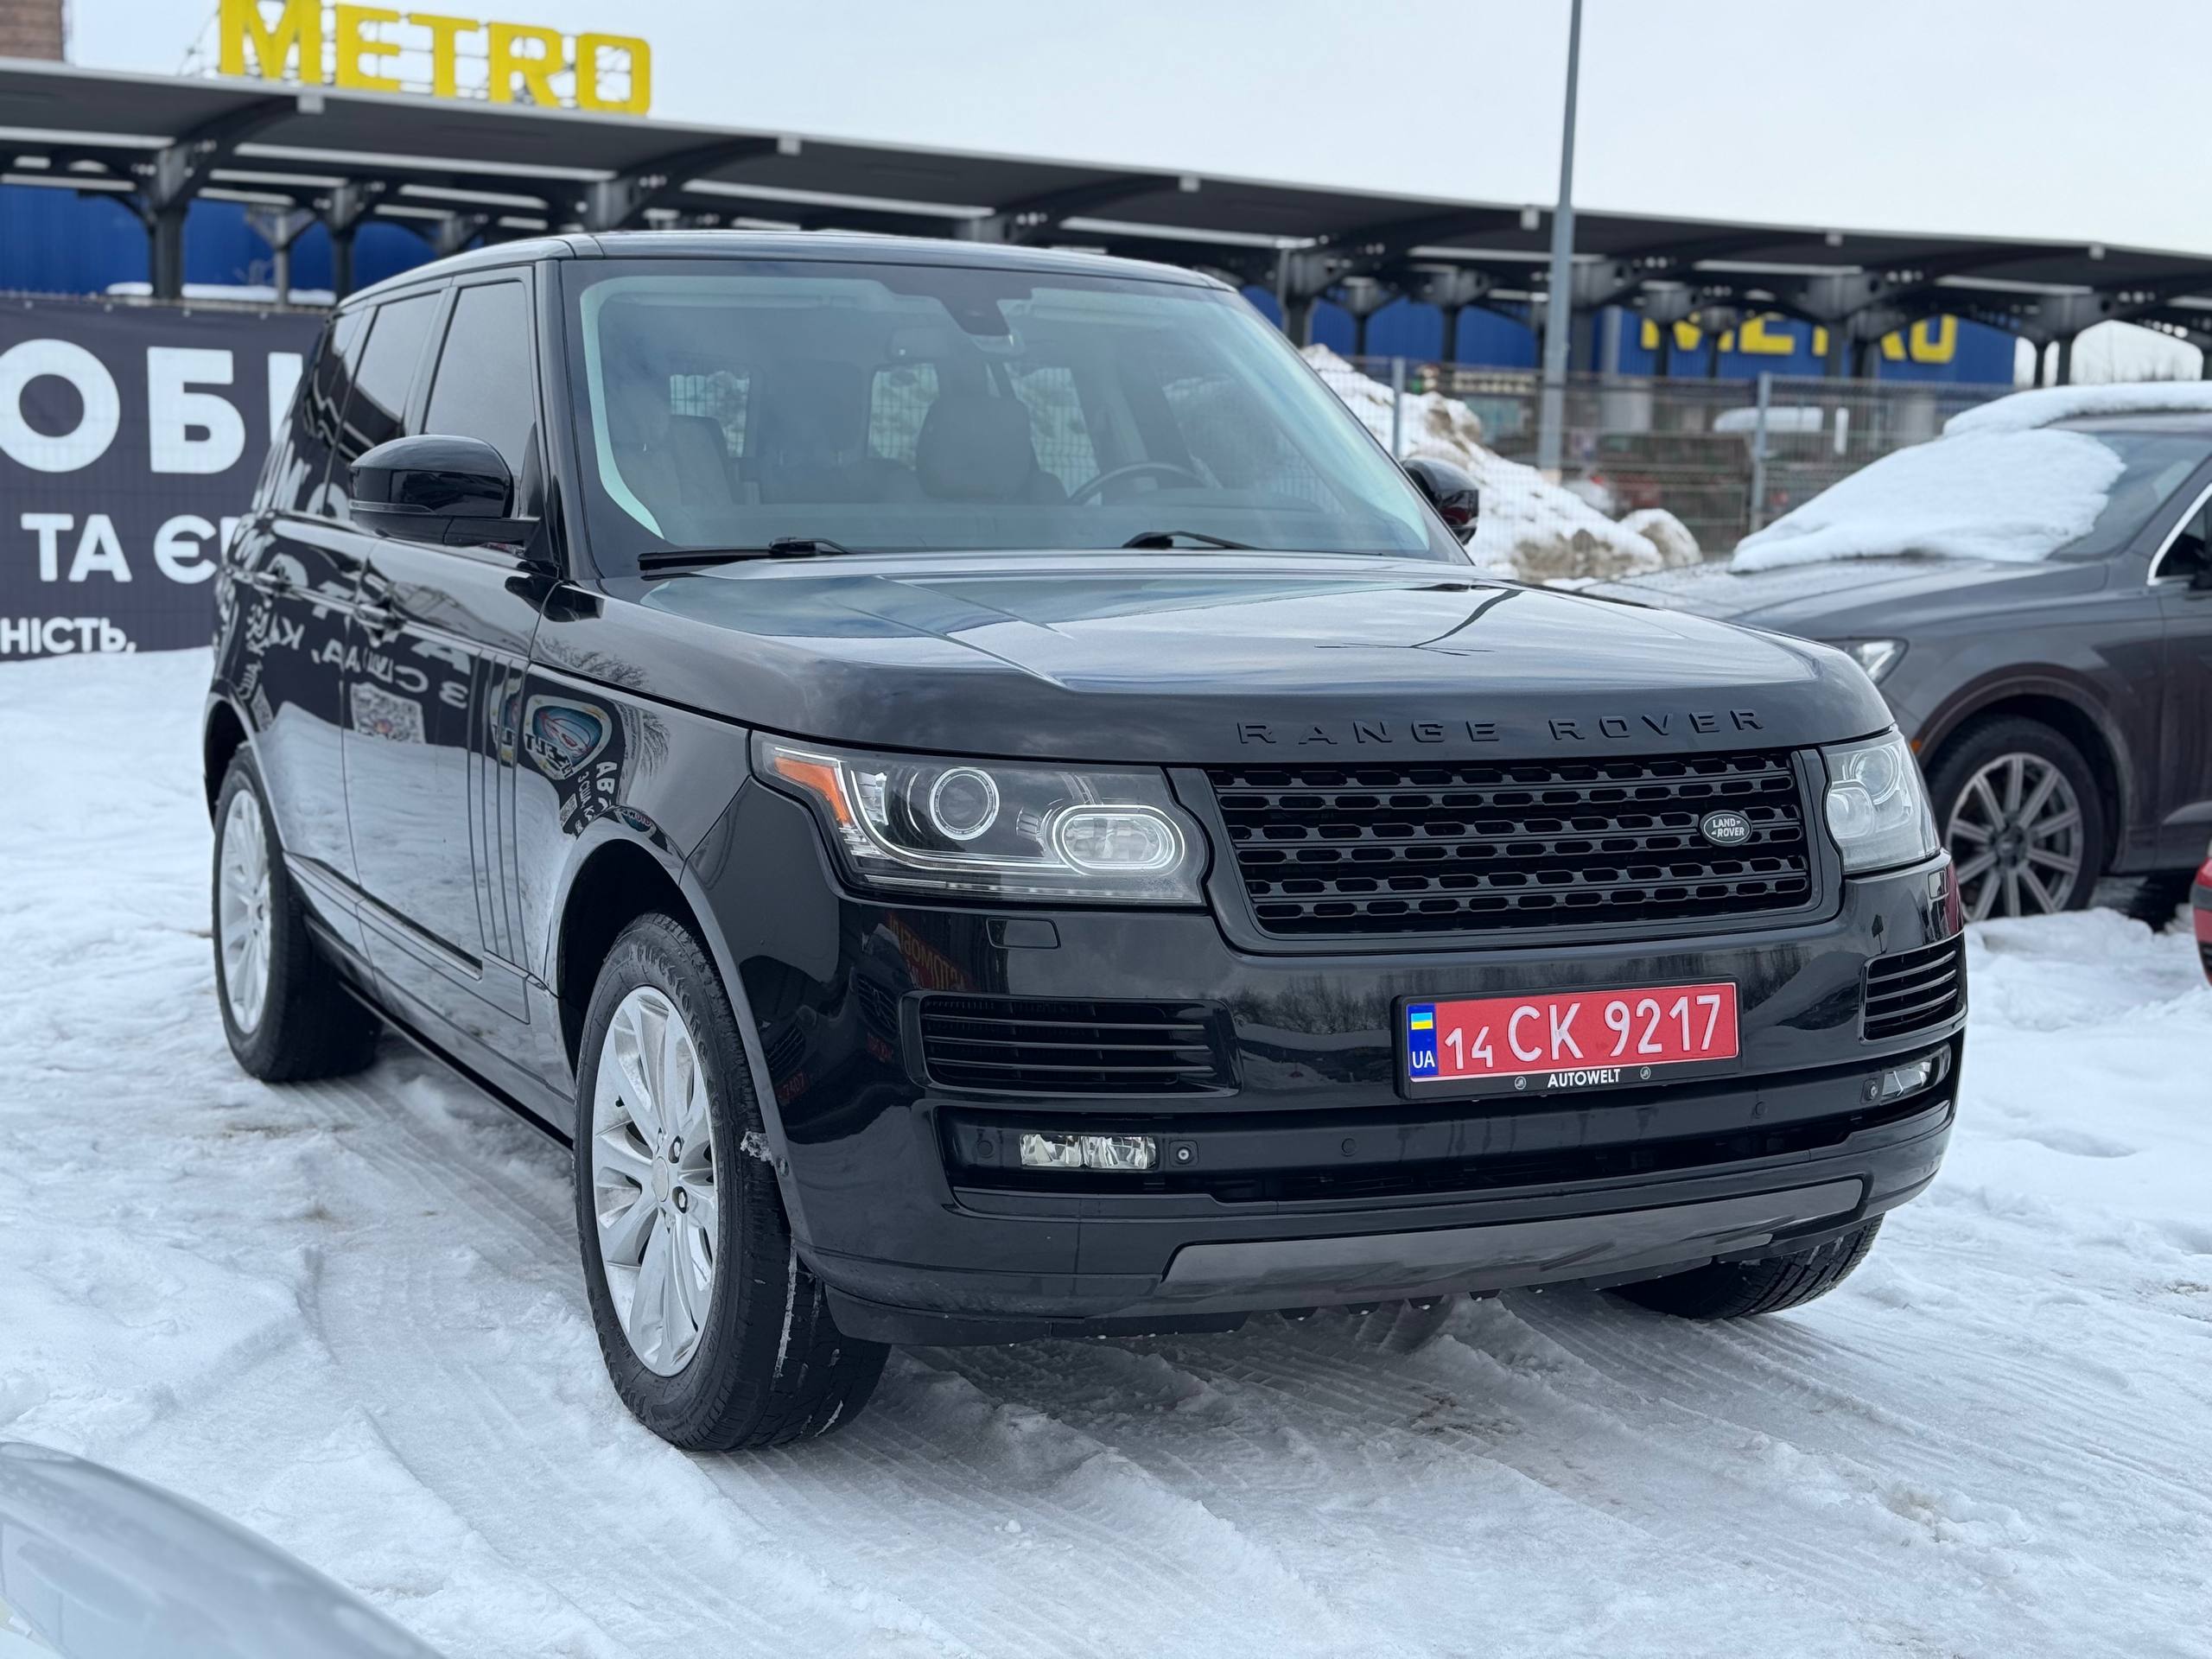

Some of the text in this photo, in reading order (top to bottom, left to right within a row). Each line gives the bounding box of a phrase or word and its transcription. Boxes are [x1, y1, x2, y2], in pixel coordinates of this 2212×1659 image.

[218, 0, 651, 116] METRO
[21, 513, 132, 582] ТА
[1236, 709, 1764, 745] RANGE ROVER
[1712, 817, 1736, 829] LAND
[1717, 827, 1745, 838] ROVER
[1445, 994, 1721, 1070] 14 CK 9217
[1412, 1050, 1435, 1069] UA
[1548, 1068, 1621, 1089] AUTOWELT
